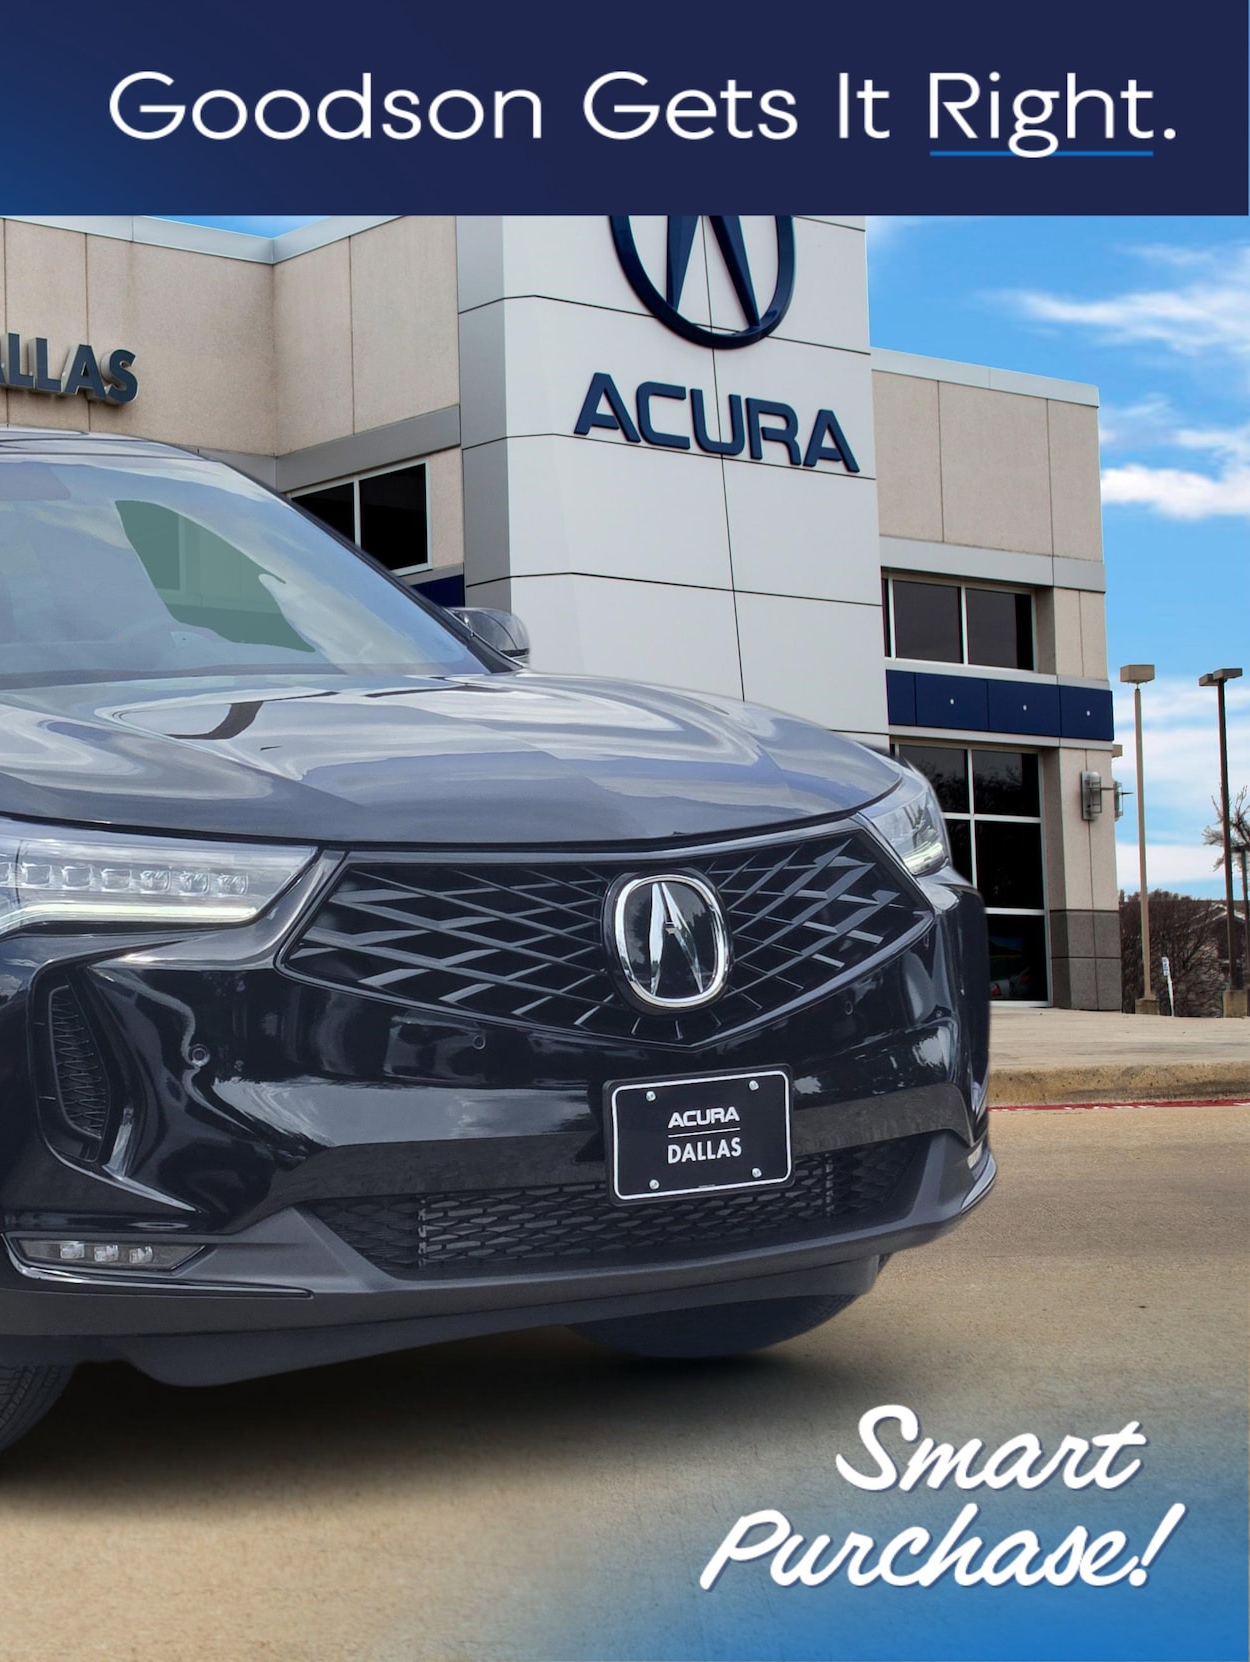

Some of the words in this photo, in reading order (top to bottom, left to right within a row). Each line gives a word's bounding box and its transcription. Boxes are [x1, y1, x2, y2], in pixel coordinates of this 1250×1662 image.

[572, 371, 861, 473] ACURA
[667, 1106, 741, 1129] ACURA
[667, 1137, 742, 1164] DALLAS
